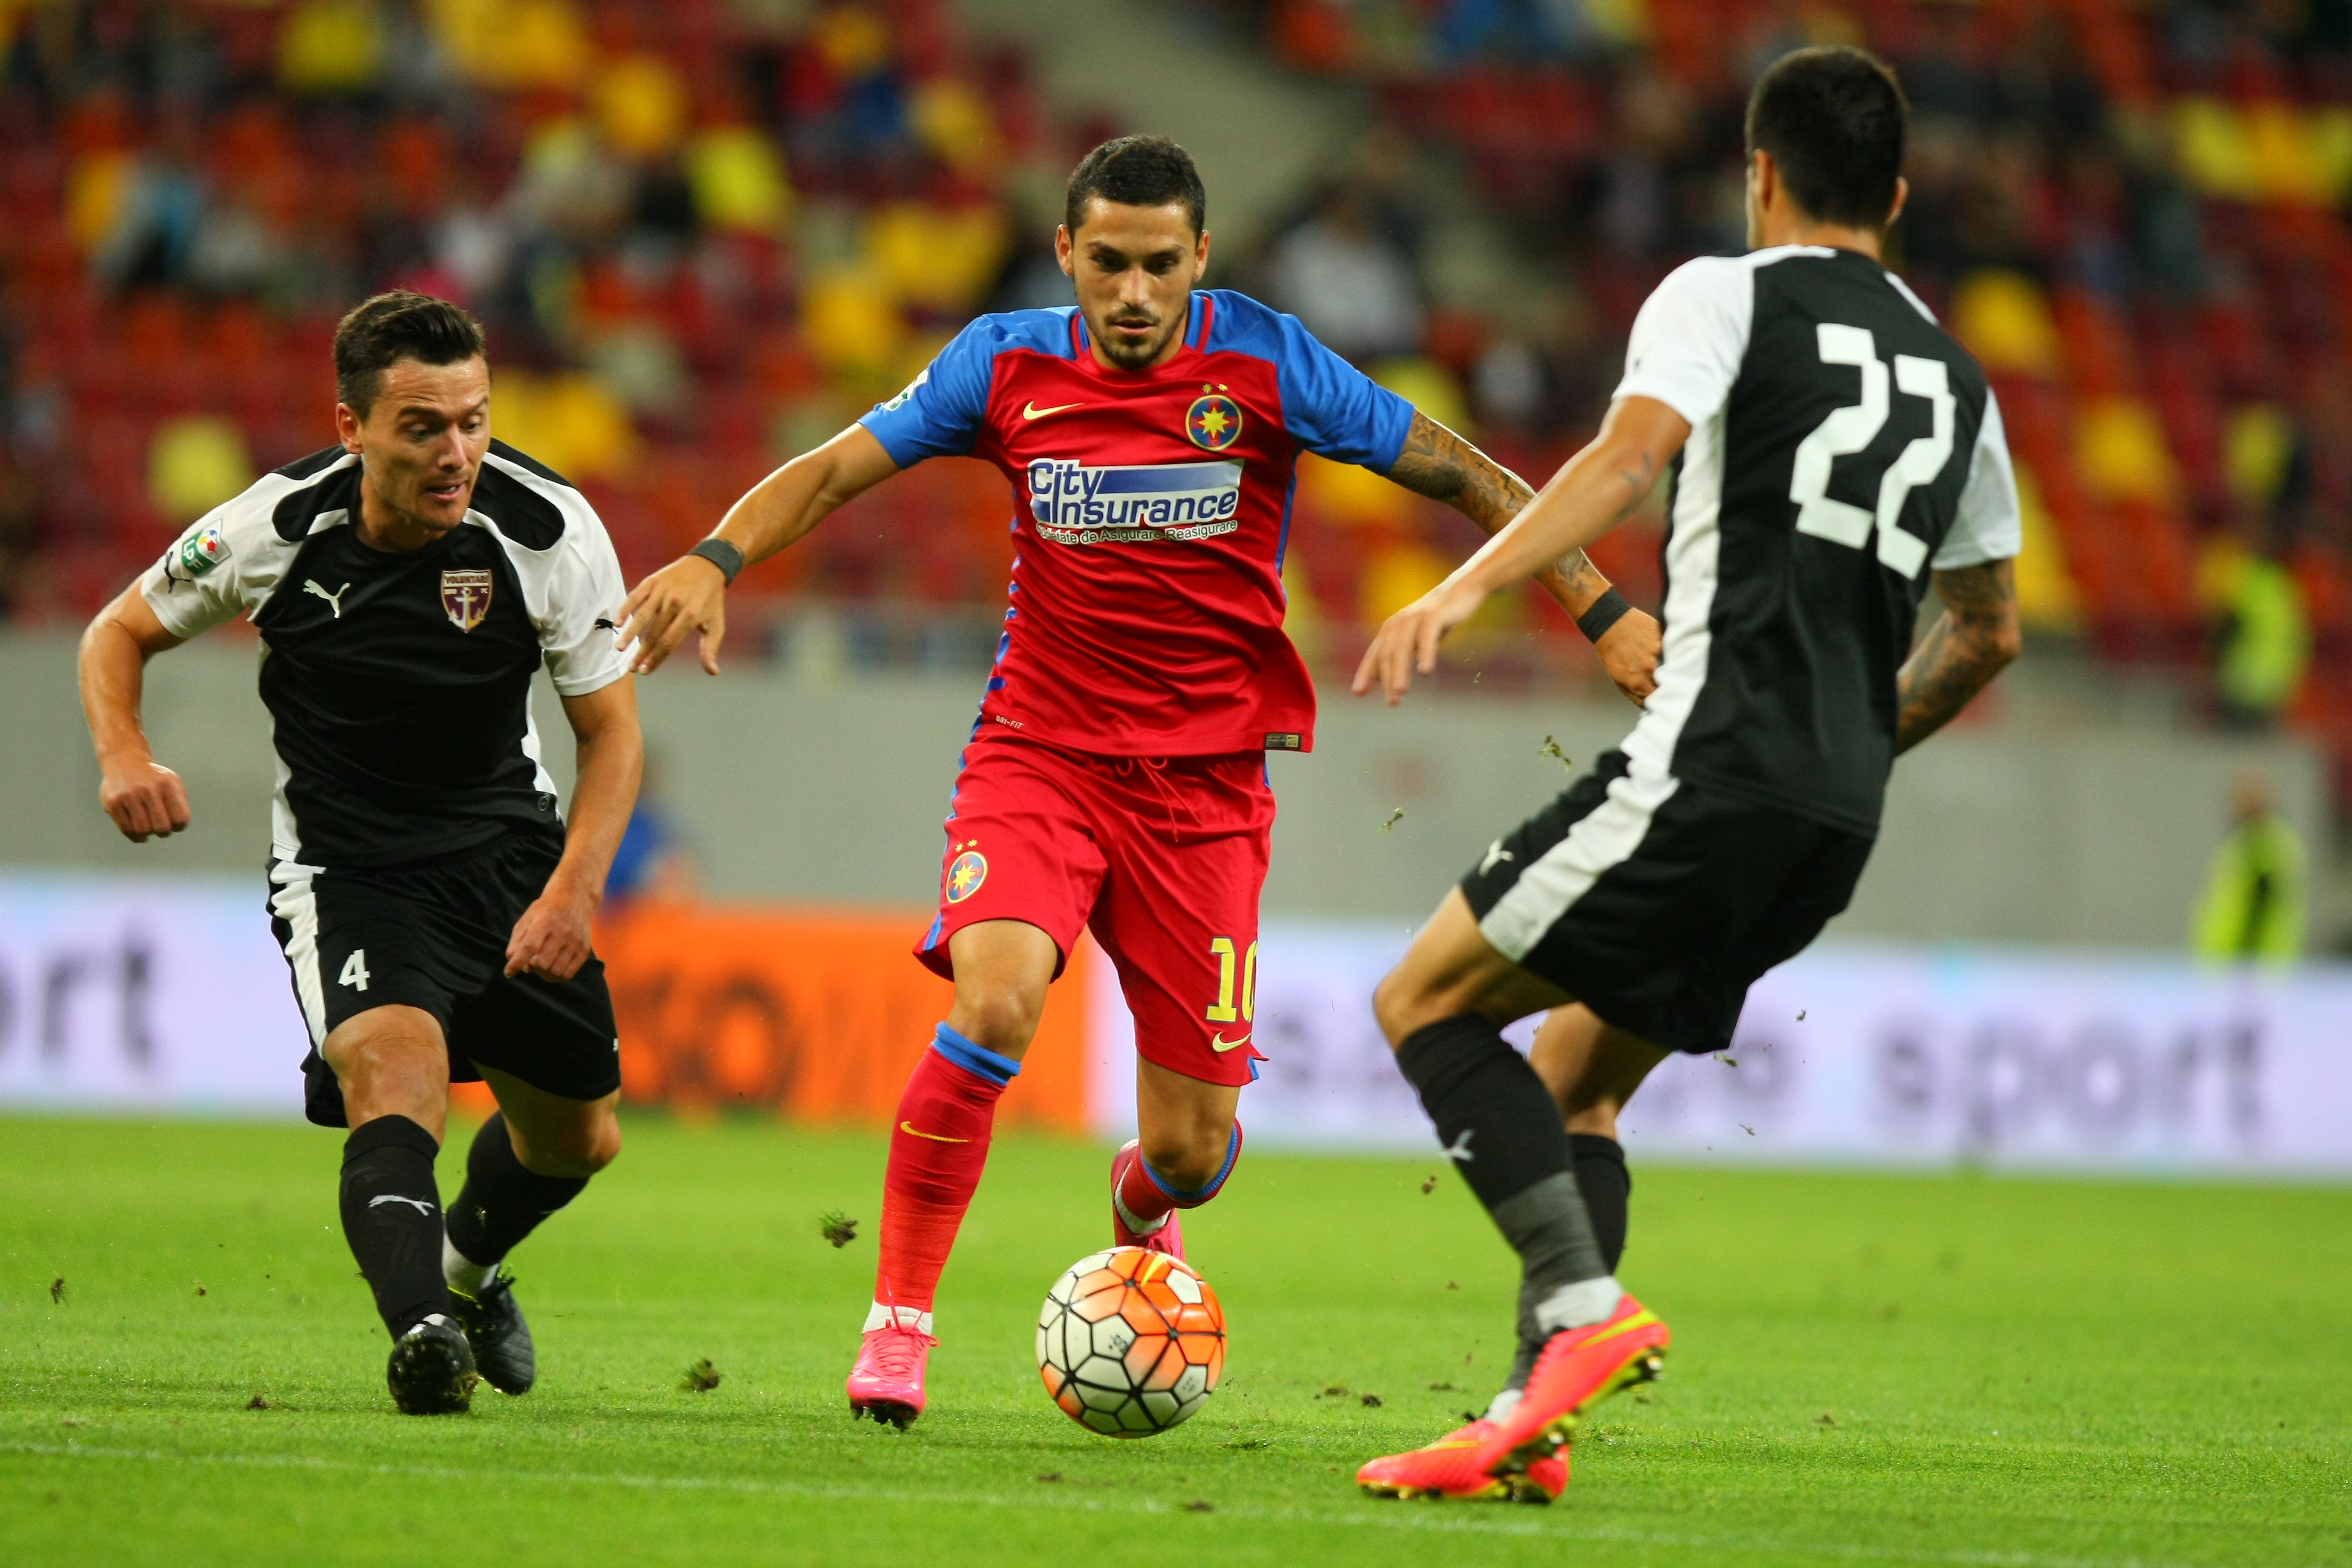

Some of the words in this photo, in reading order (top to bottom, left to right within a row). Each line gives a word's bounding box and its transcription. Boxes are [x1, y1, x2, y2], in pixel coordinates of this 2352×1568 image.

[1789, 322, 1956, 580] 22
[1030, 461, 1105, 505] City
[1052, 491, 1237, 525] Insurance
[183, 538, 203, 568] LPF
[1081, 531, 1099, 543] de
[338, 949, 370, 991] 4
[1206, 936, 1258, 1023] 10
